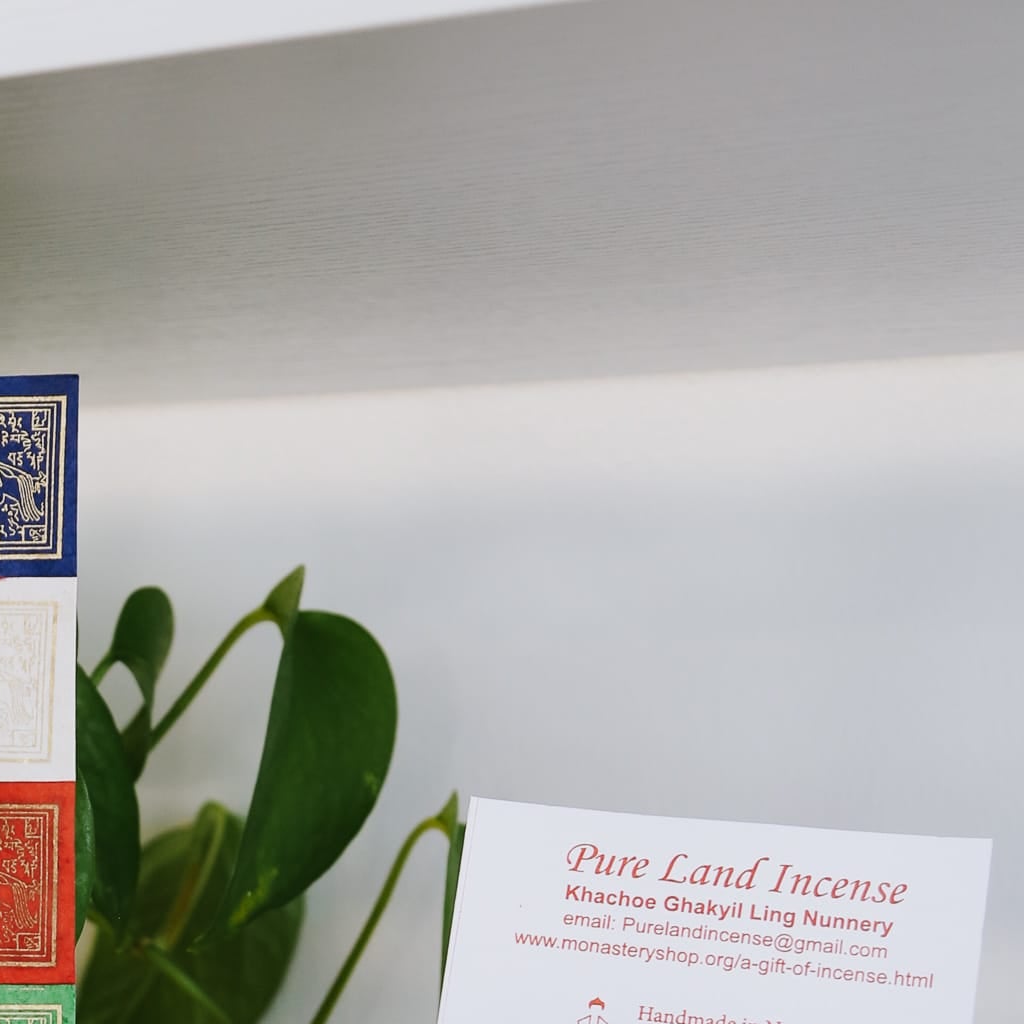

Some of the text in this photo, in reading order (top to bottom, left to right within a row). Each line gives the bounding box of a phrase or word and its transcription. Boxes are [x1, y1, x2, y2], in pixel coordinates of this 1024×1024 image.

[566, 843, 908, 905] Pure Land Incense
[563, 913, 888, 958] email: Purelandincense@gmail.com
[564, 884, 894, 938] Khachoe Ghakyil Ling Nunnery
[514, 932, 934, 989] www.monasteryshop.org/a-gift-of-incense.html
